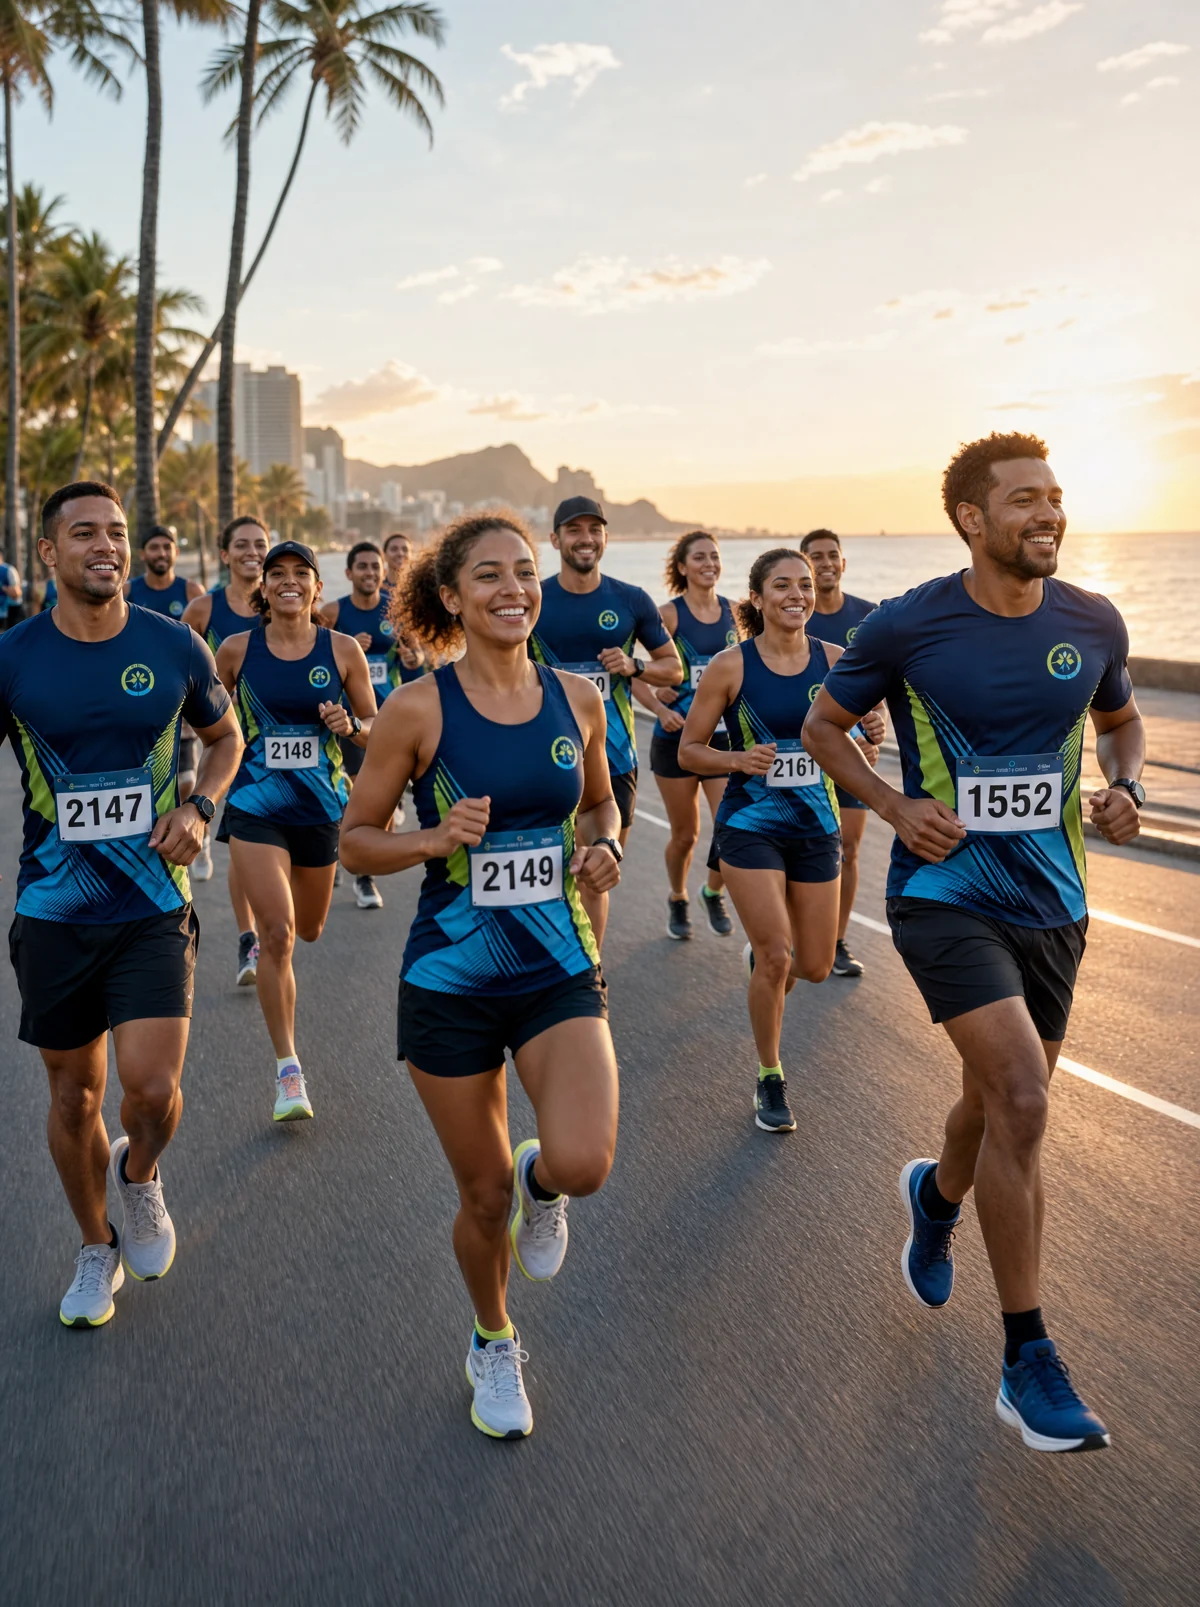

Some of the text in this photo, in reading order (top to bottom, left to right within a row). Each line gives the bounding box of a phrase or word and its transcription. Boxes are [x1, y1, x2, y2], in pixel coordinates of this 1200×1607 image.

[271, 741, 312, 760] 2148
[773, 757, 815, 778] 2161
[66, 792, 142, 828] 2147
[968, 781, 1052, 819] 1552
[482, 855, 554, 892] 2149
